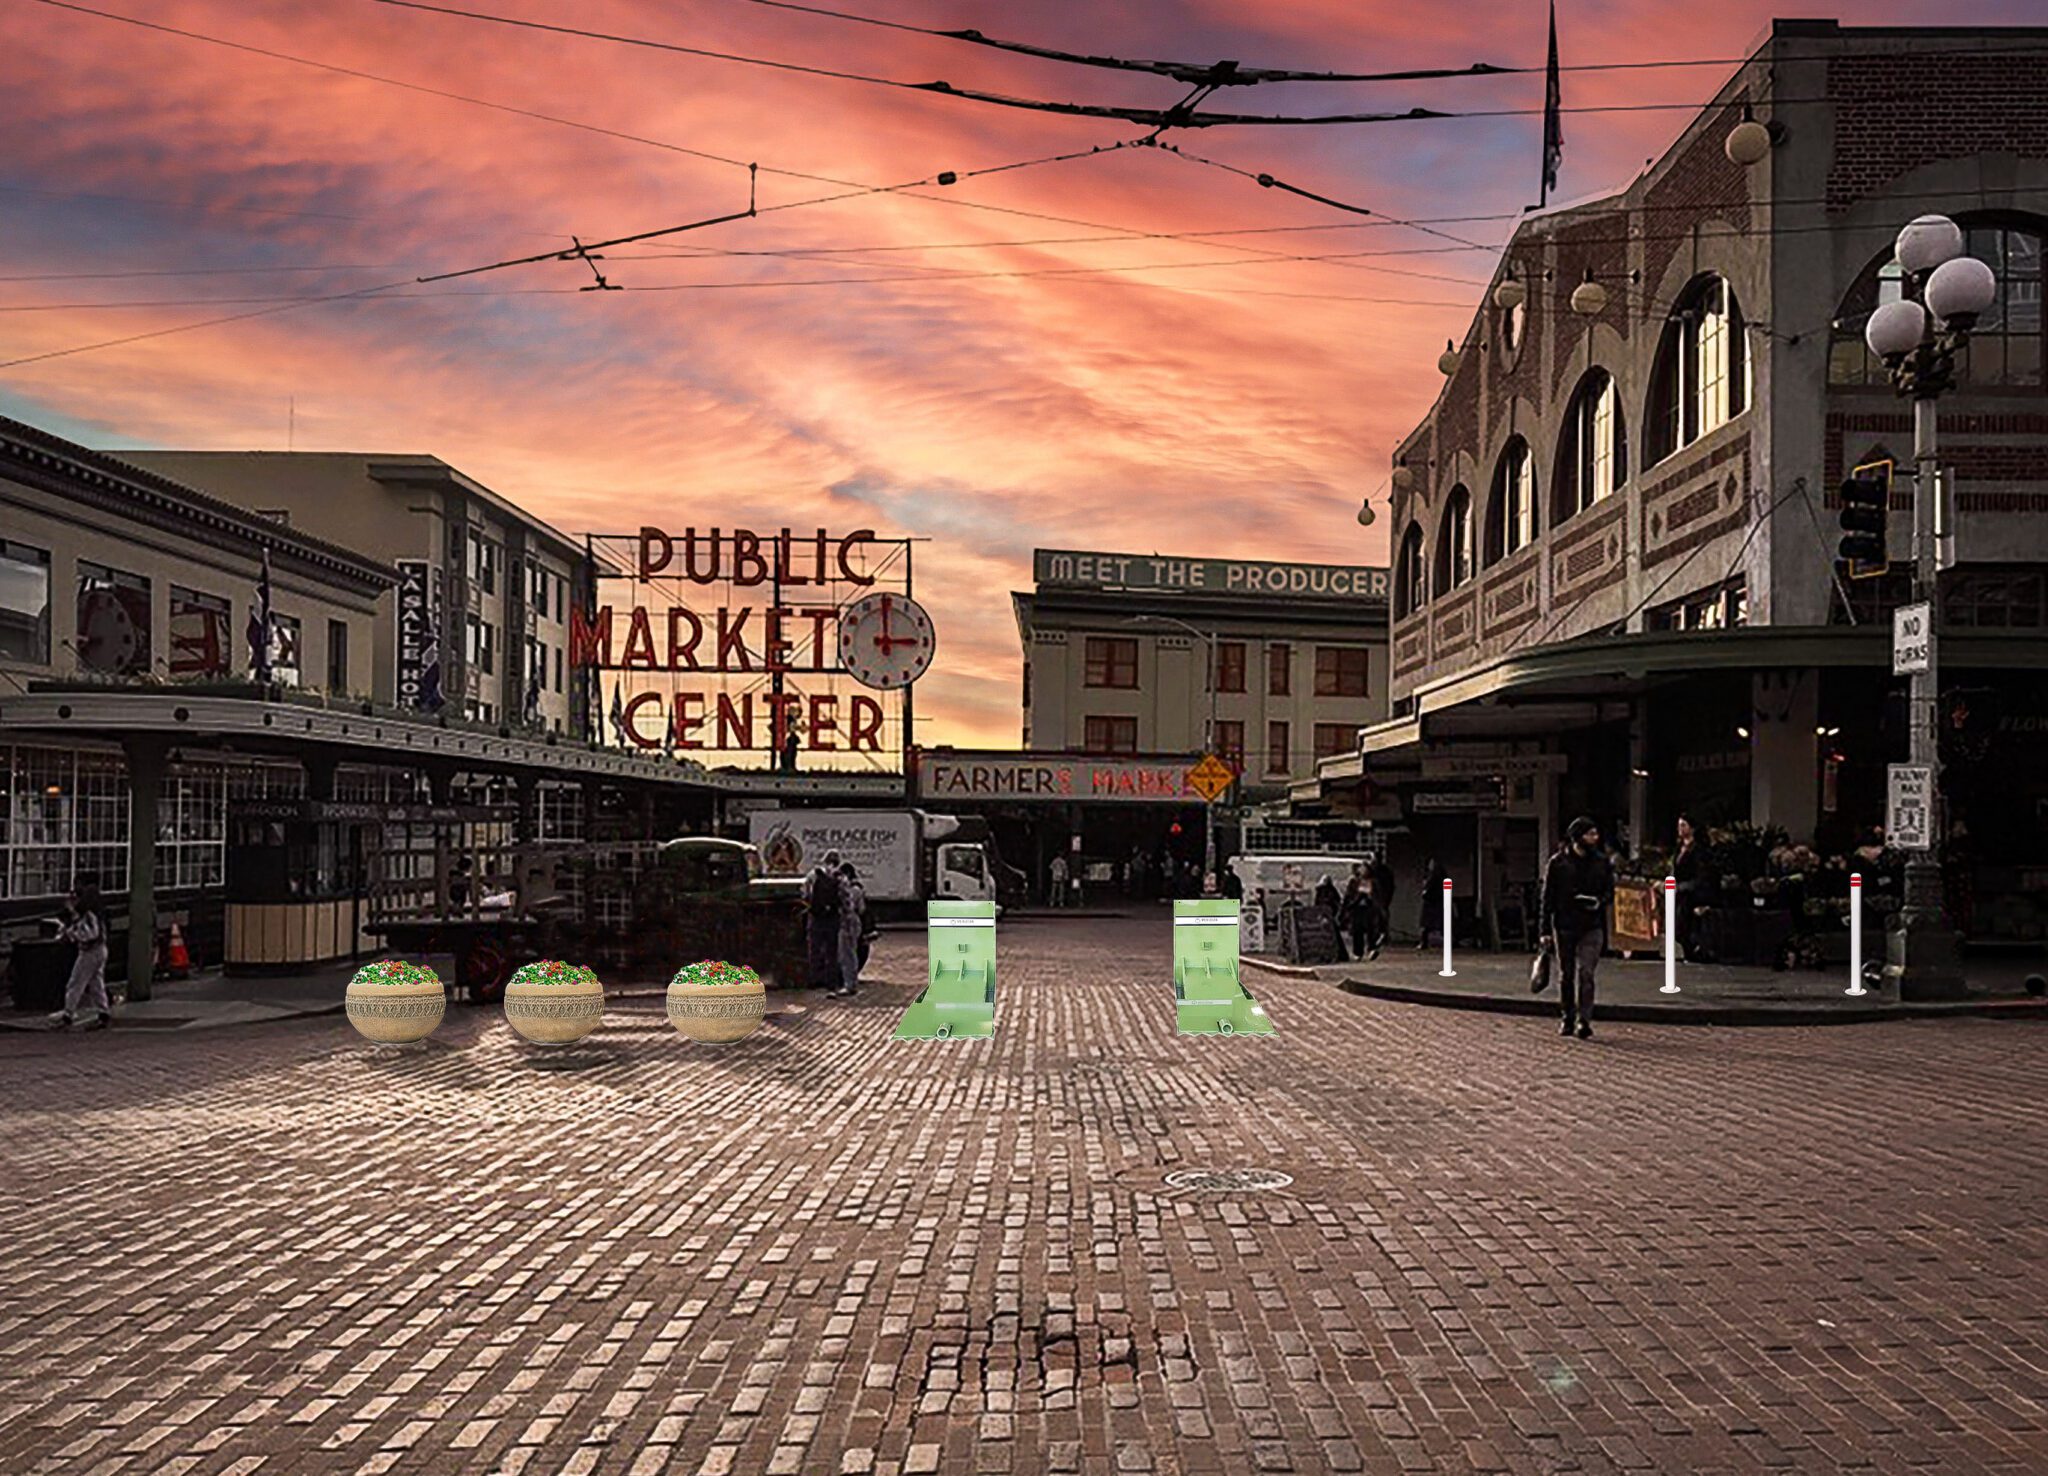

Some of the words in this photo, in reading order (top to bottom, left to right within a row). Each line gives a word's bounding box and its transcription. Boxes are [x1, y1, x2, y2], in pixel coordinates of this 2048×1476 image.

[639, 525, 875, 587] PUBLIC
[1049, 554, 1131, 583] MEET
[1149, 560, 1205, 587] THE
[570, 605, 841, 673] MARKET
[1902, 616, 1922, 637] NO
[621, 691, 884, 753] CENTER
[934, 766, 1072, 794] FARMERS
[802, 829, 828, 842] PIKE
[830, 829, 868, 841] PLACE
[870, 829, 896, 841] FISH
